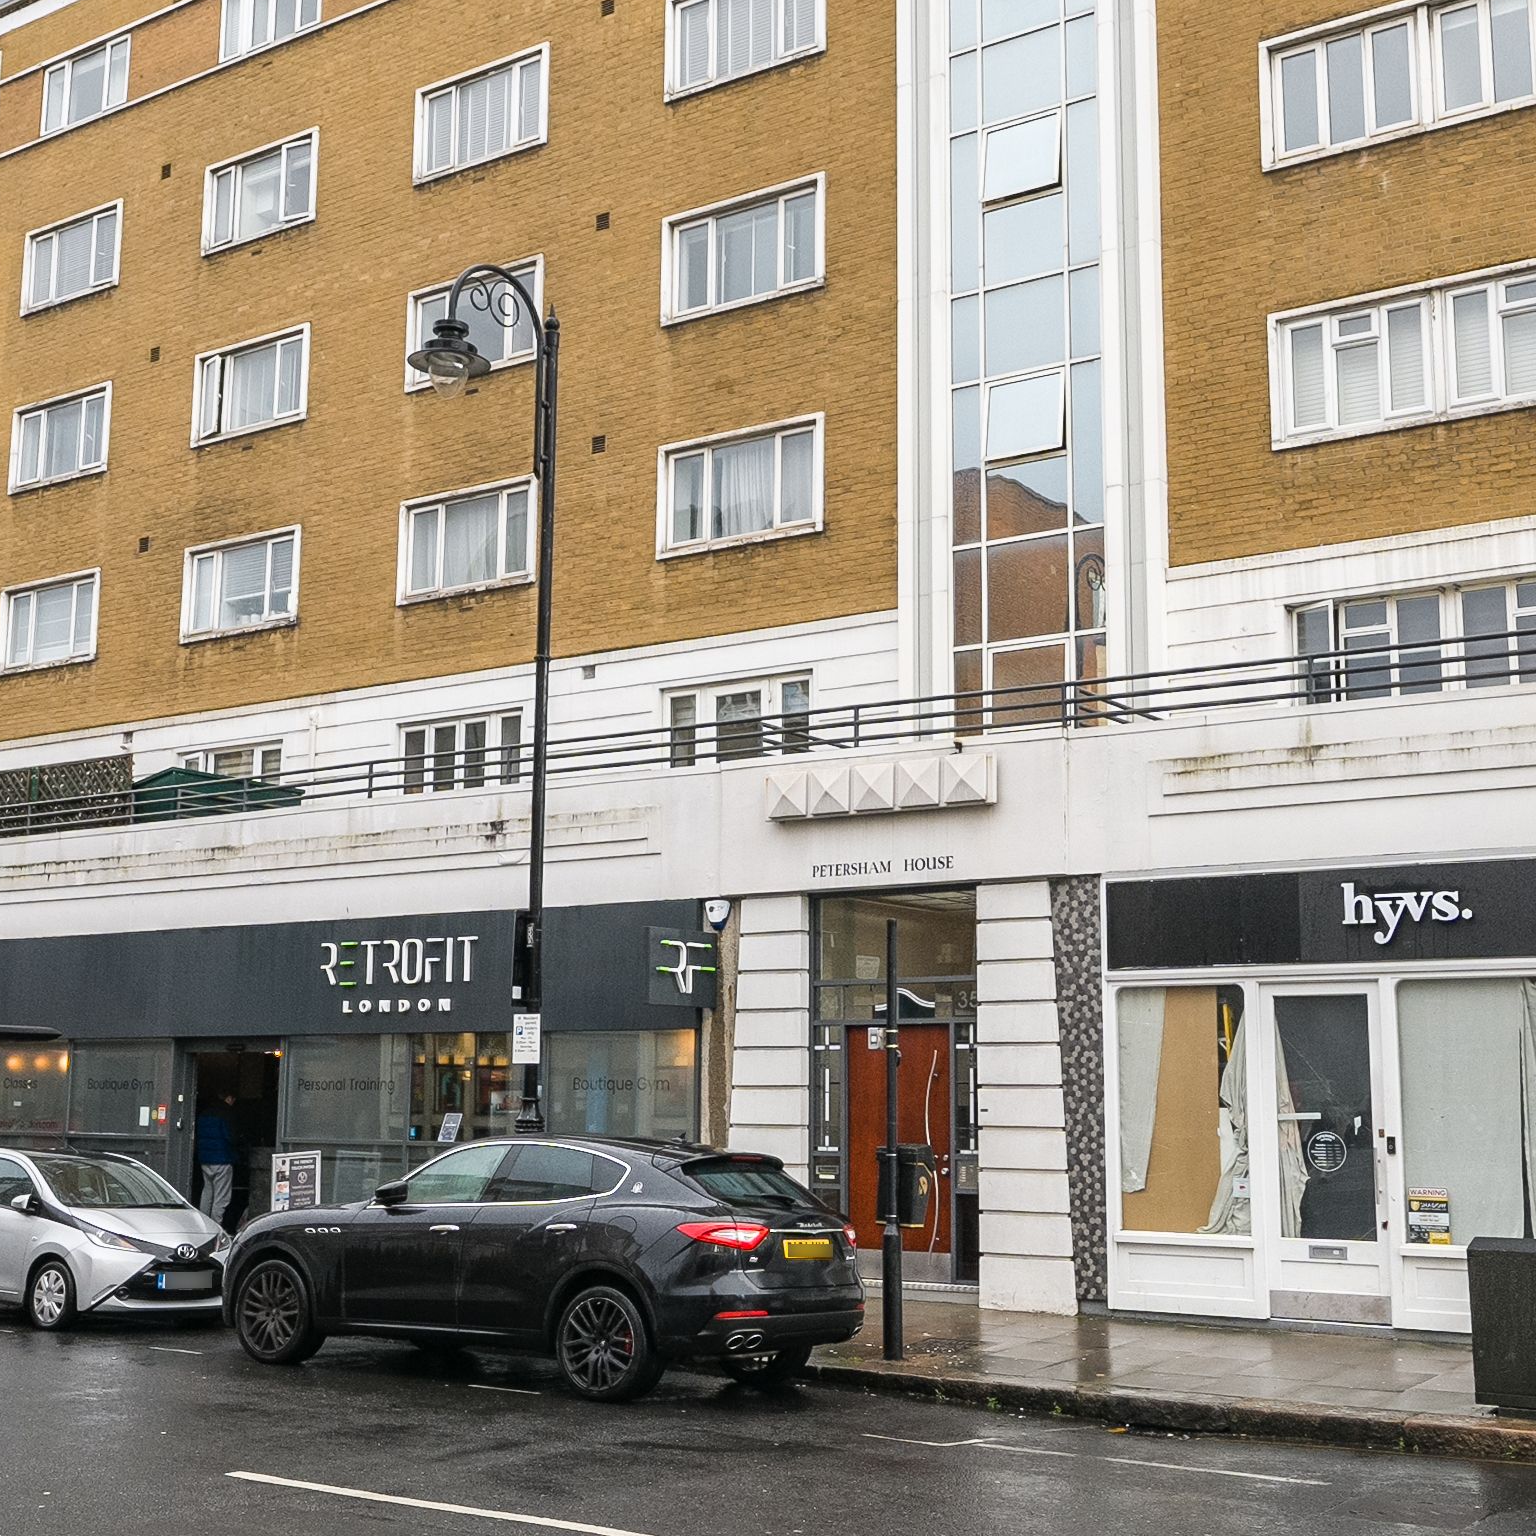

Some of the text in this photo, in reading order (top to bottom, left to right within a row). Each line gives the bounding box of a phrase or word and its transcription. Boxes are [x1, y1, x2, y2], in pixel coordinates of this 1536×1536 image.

[812, 855, 954, 877] PETERSHAM HOUSE
[1340, 882, 1473, 944] hyvs.
[320, 936, 479, 986] RETROFIT
[341, 998, 451, 1013] LONDON
[87, 1078, 154, 1093] Boutique Gym
[297, 1078, 395, 1096] Personal Training
[572, 1077, 670, 1095] Boutique Gym
